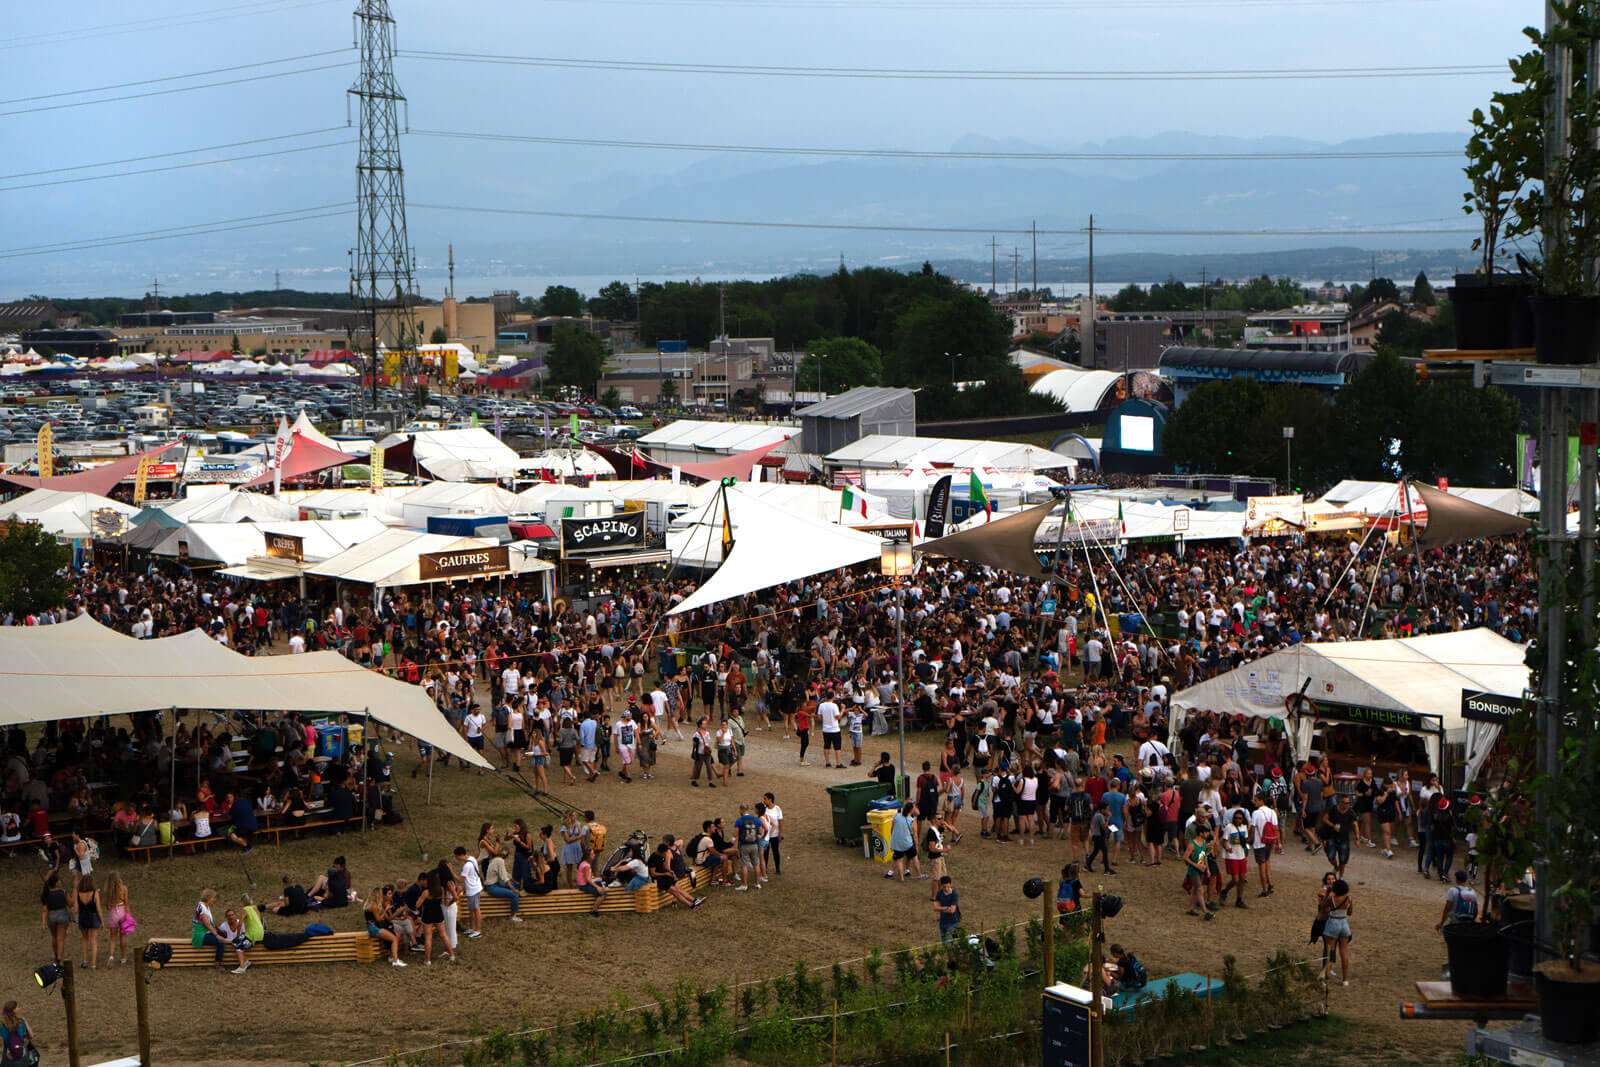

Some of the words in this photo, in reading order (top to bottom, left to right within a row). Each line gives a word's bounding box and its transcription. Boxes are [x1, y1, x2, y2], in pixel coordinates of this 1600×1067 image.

[275, 435, 285, 469] KEBAB
[573, 520, 638, 543] SCAPINO
[438, 552, 490, 568] GAUFRES
[1348, 705, 1363, 719] LA
